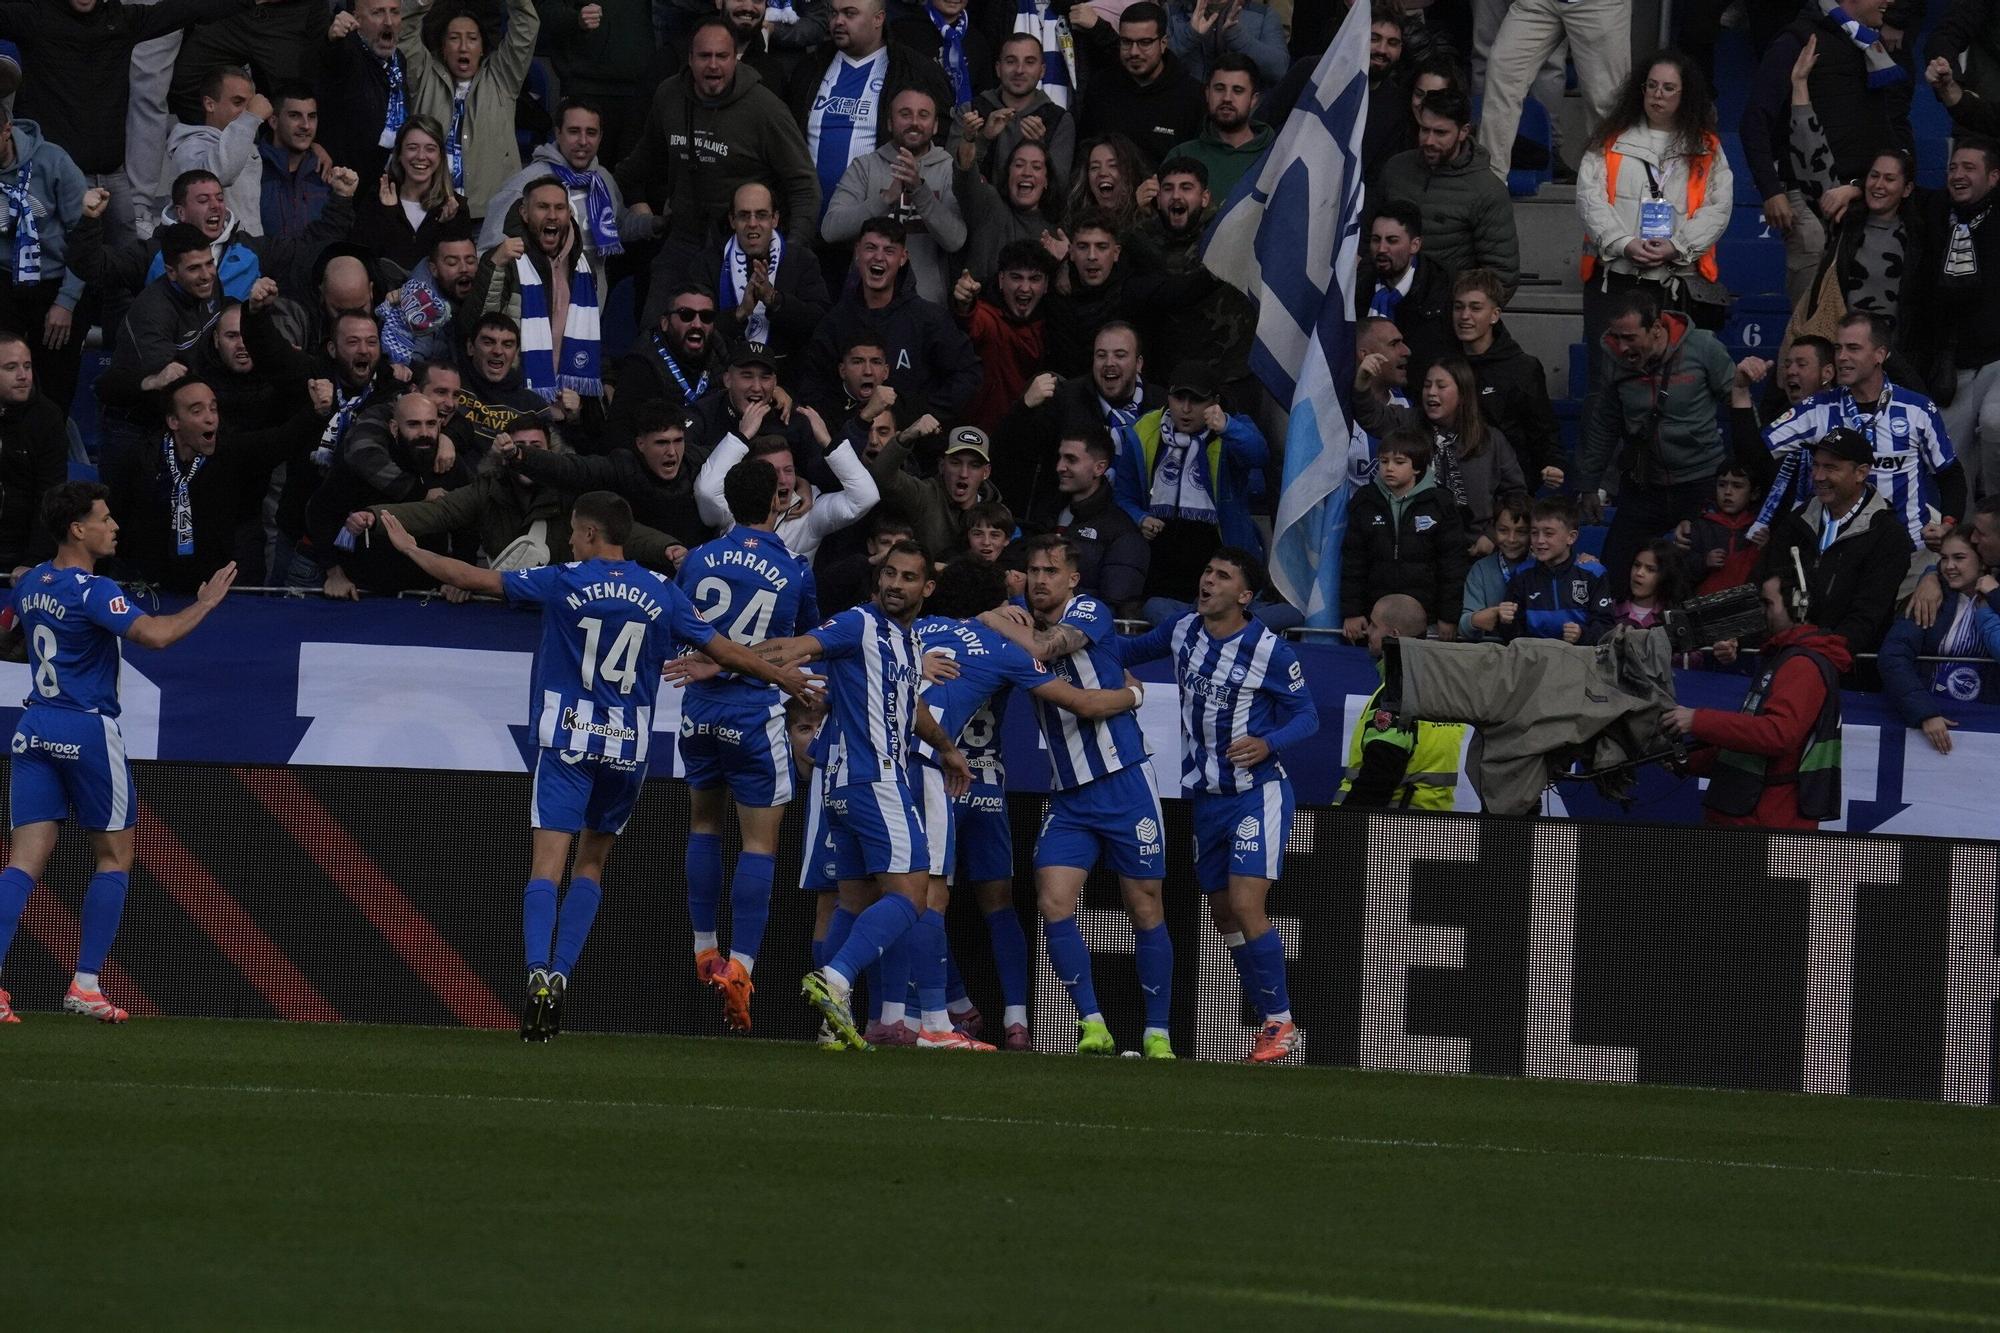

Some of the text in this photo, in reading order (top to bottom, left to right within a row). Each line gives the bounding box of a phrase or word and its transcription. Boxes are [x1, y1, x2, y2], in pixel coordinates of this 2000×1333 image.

[703, 139, 729, 157] ALAVÉS
[1742, 323, 1761, 347] 6
[750, 343, 763, 353] W
[895, 349, 911, 370] A
[22, 593, 66, 620] BLANCO
[566, 582, 663, 622] N.TENAGLIA
[696, 576, 778, 647] 24
[33, 624, 60, 698] 8
[577, 617, 646, 694] 14
[561, 706, 637, 742] Kutxabank
[698, 722, 710, 735] El
[1139, 843, 1161, 856] EMB
[1235, 841, 1259, 853] EMB
